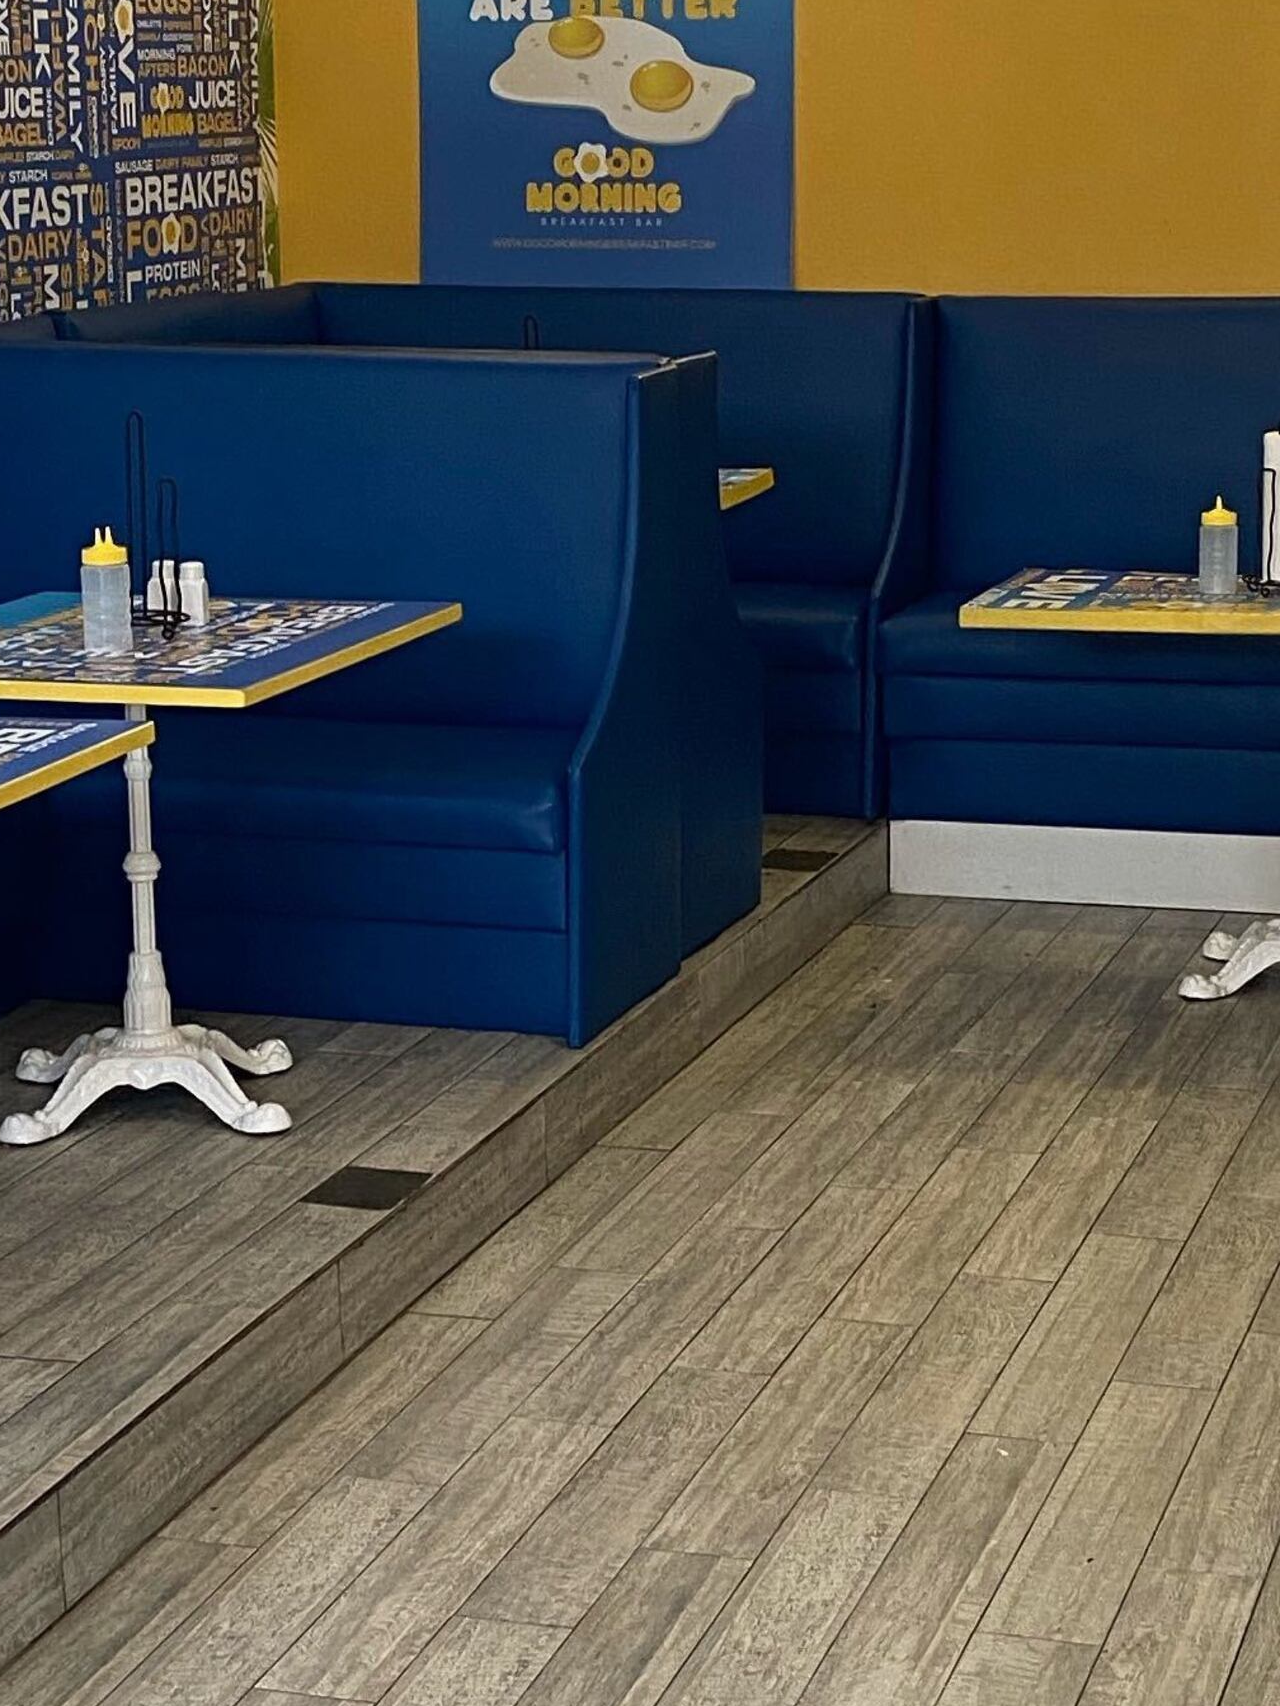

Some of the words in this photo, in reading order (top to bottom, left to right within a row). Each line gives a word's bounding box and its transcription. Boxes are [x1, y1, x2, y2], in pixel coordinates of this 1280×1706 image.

[187, 80, 236, 109] JUICE
[553, 142, 654, 182] GOOD
[526, 181, 682, 213] MORNING
[540, 216, 626, 226] BREAKFAST
[635, 216, 664, 227] BAR
